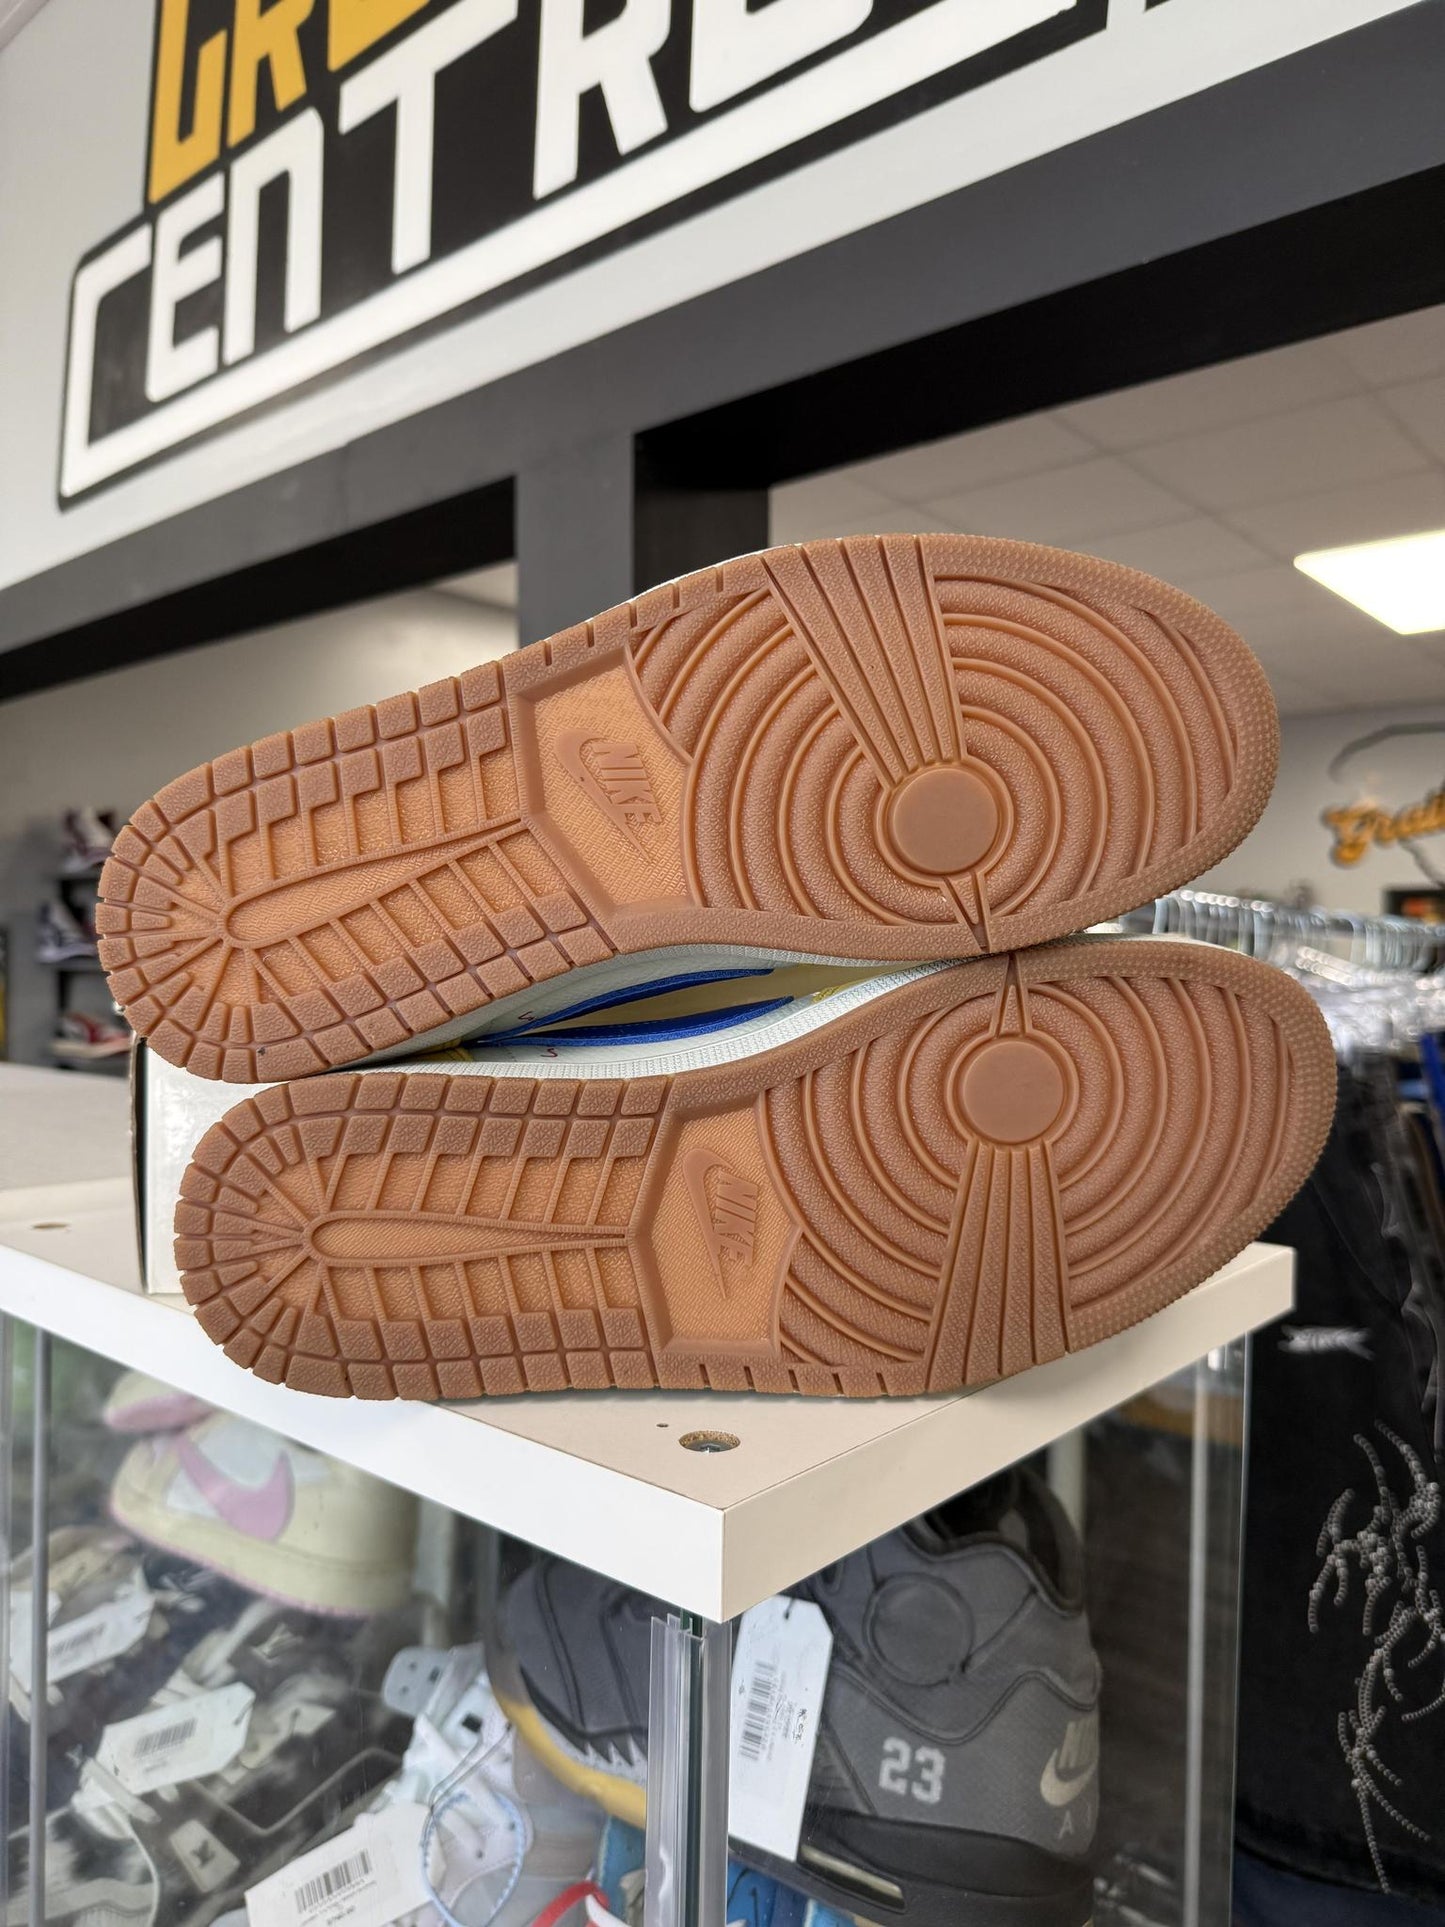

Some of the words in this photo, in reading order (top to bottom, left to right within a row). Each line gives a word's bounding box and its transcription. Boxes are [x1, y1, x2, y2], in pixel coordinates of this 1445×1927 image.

[591, 742, 663, 824] NIKE
[713, 1169, 759, 1267] NIKE
[879, 1736, 946, 1804] 23
